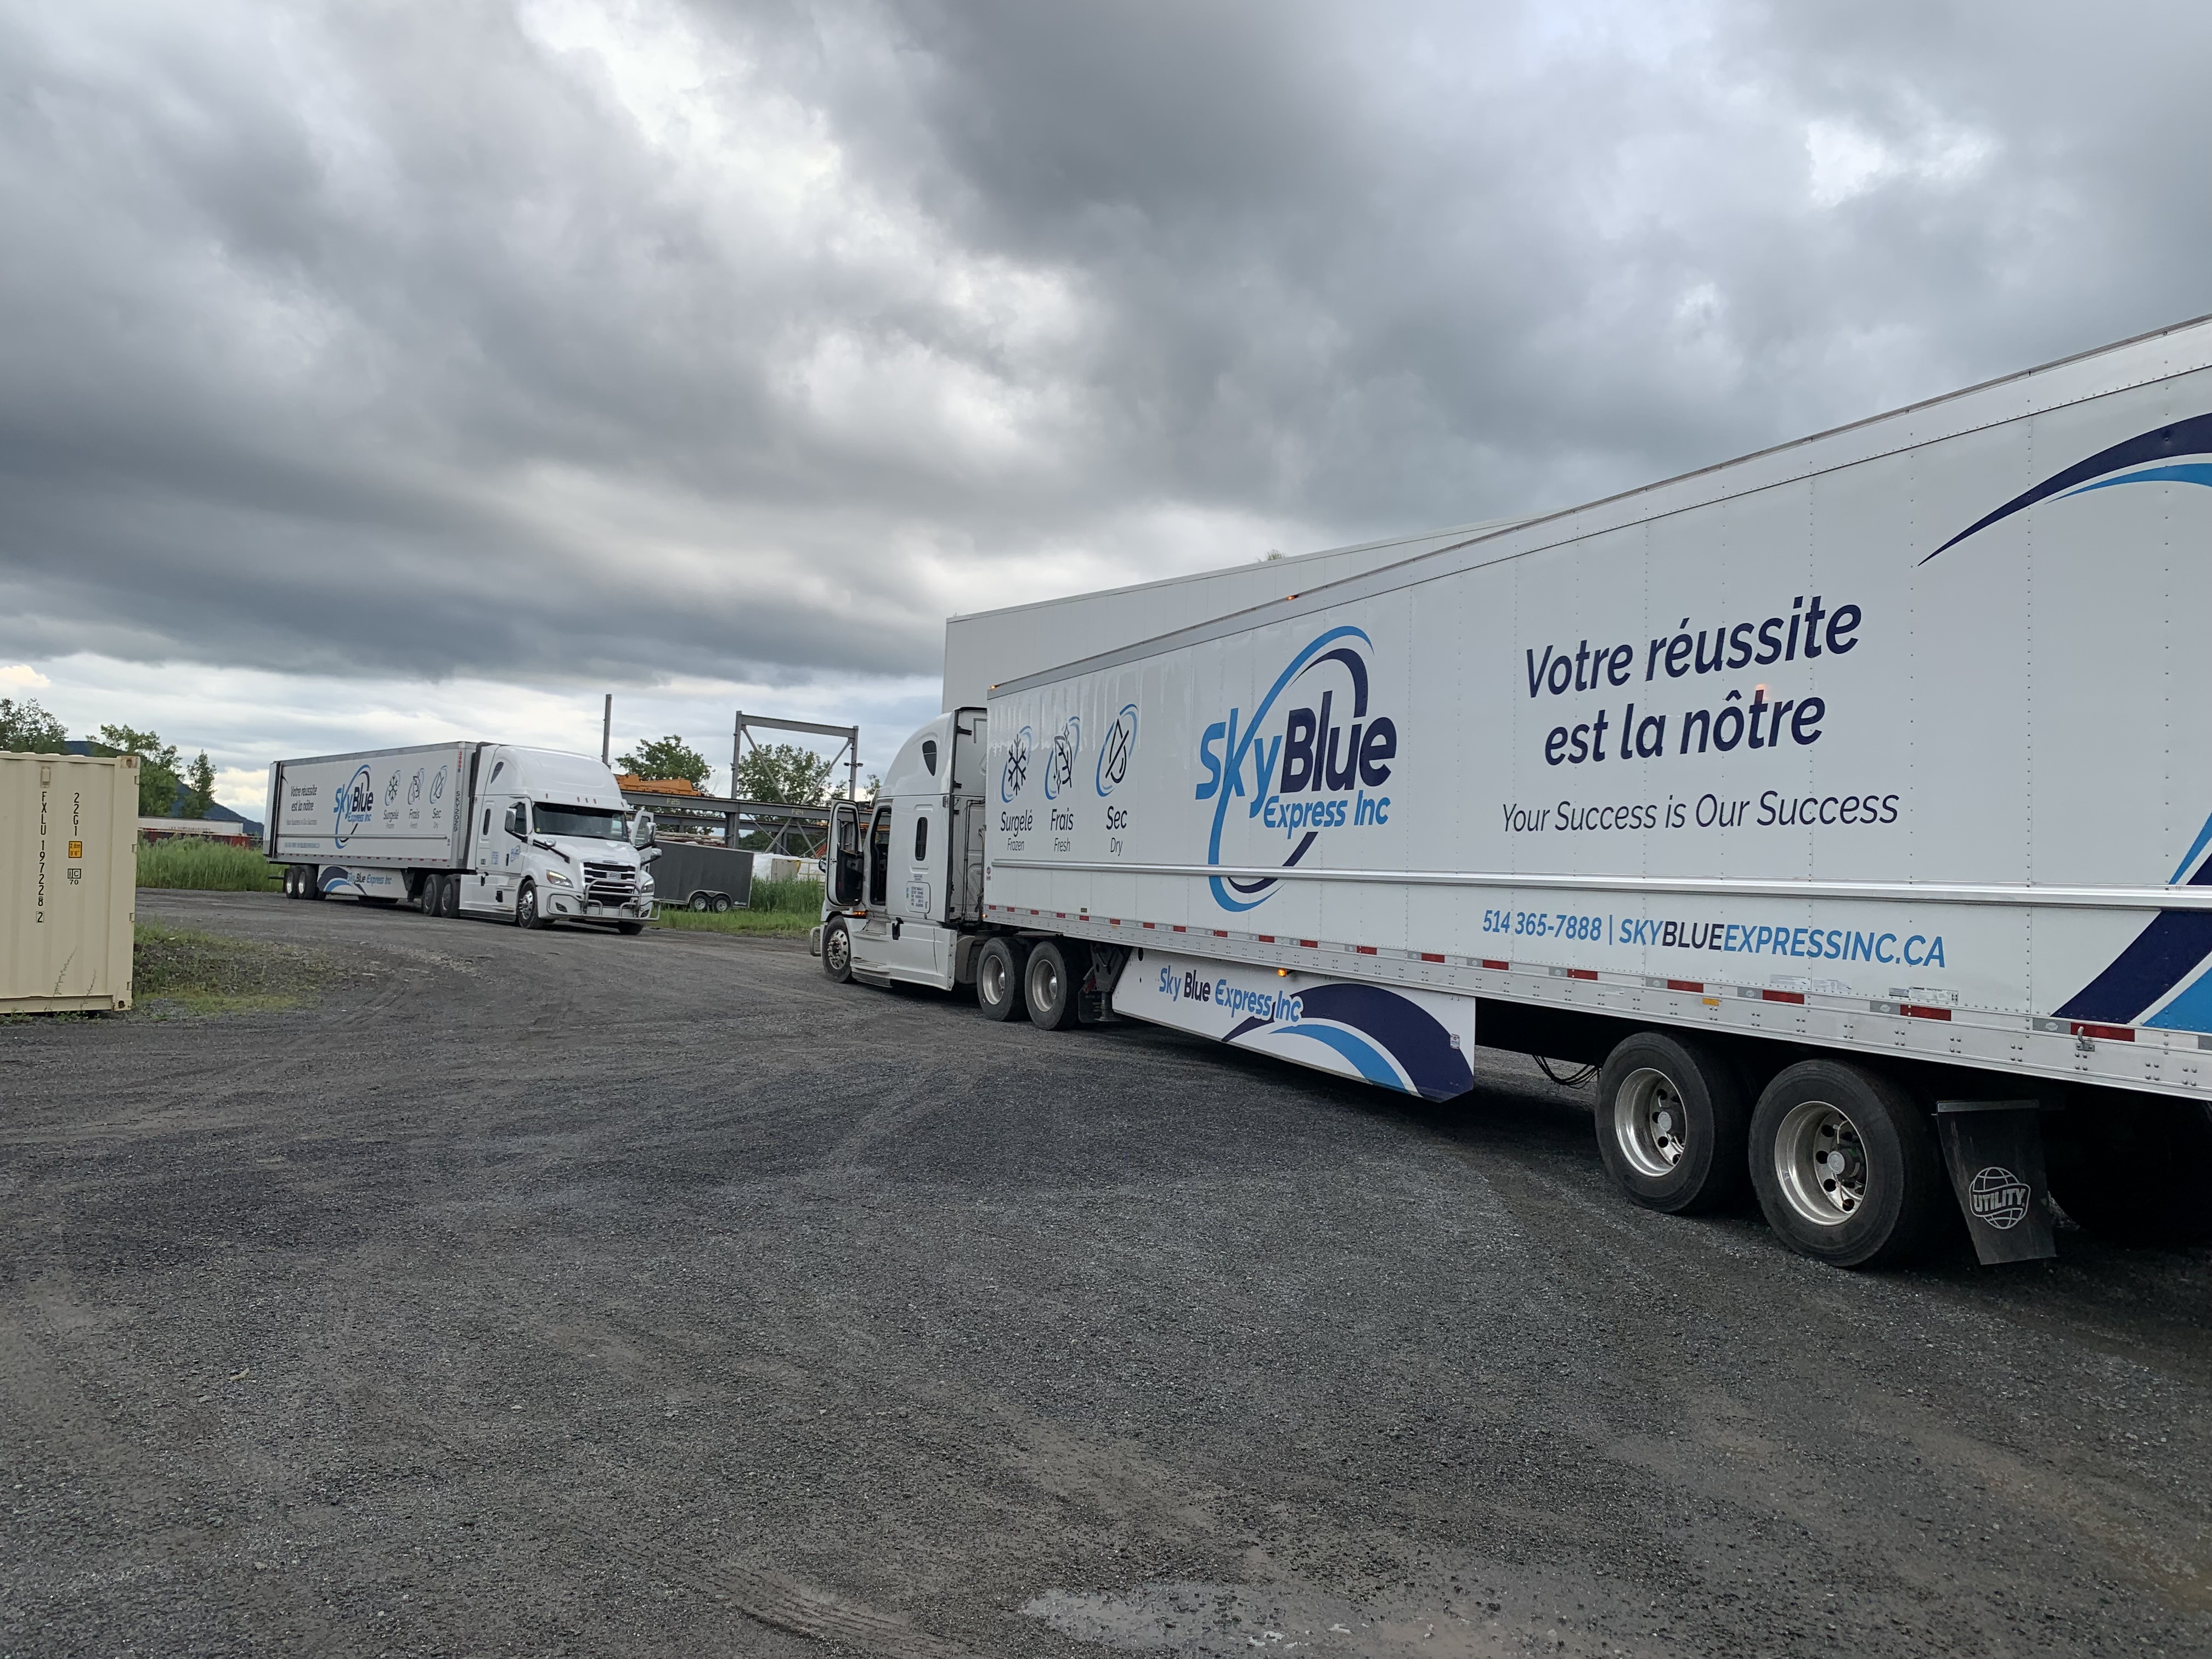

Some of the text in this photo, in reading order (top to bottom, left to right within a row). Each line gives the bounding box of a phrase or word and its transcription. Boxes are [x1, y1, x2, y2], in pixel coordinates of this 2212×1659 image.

[1526, 595, 1862, 698] Votre réussite
[1544, 689, 1826, 766] est la nôtre
[409, 809, 420, 819] Frais
[432, 808, 441, 819] Sec
[1001, 809, 1033, 837] Surgelé
[1050, 808, 1074, 831] Frais
[1106, 805, 1127, 830] Sec
[1265, 790, 1391, 839] Express Inc
[1503, 790, 1899, 832] Your Success is Our Success
[1007, 838, 1024, 851] Frozen
[1054, 838, 1070, 851] Fresh
[1110, 838, 1123, 856] Dry
[37, 912, 43, 923] 2
[1483, 910, 1511, 934] 514
[1515, 912, 1602, 942] 365-7888
[1619, 918, 1945, 968] SKYBLUEEXPRESSINC.CA
[1159, 965, 1301, 1022] Sky Blue Express Inc
[1973, 1188, 2025, 1212] UTILITY
